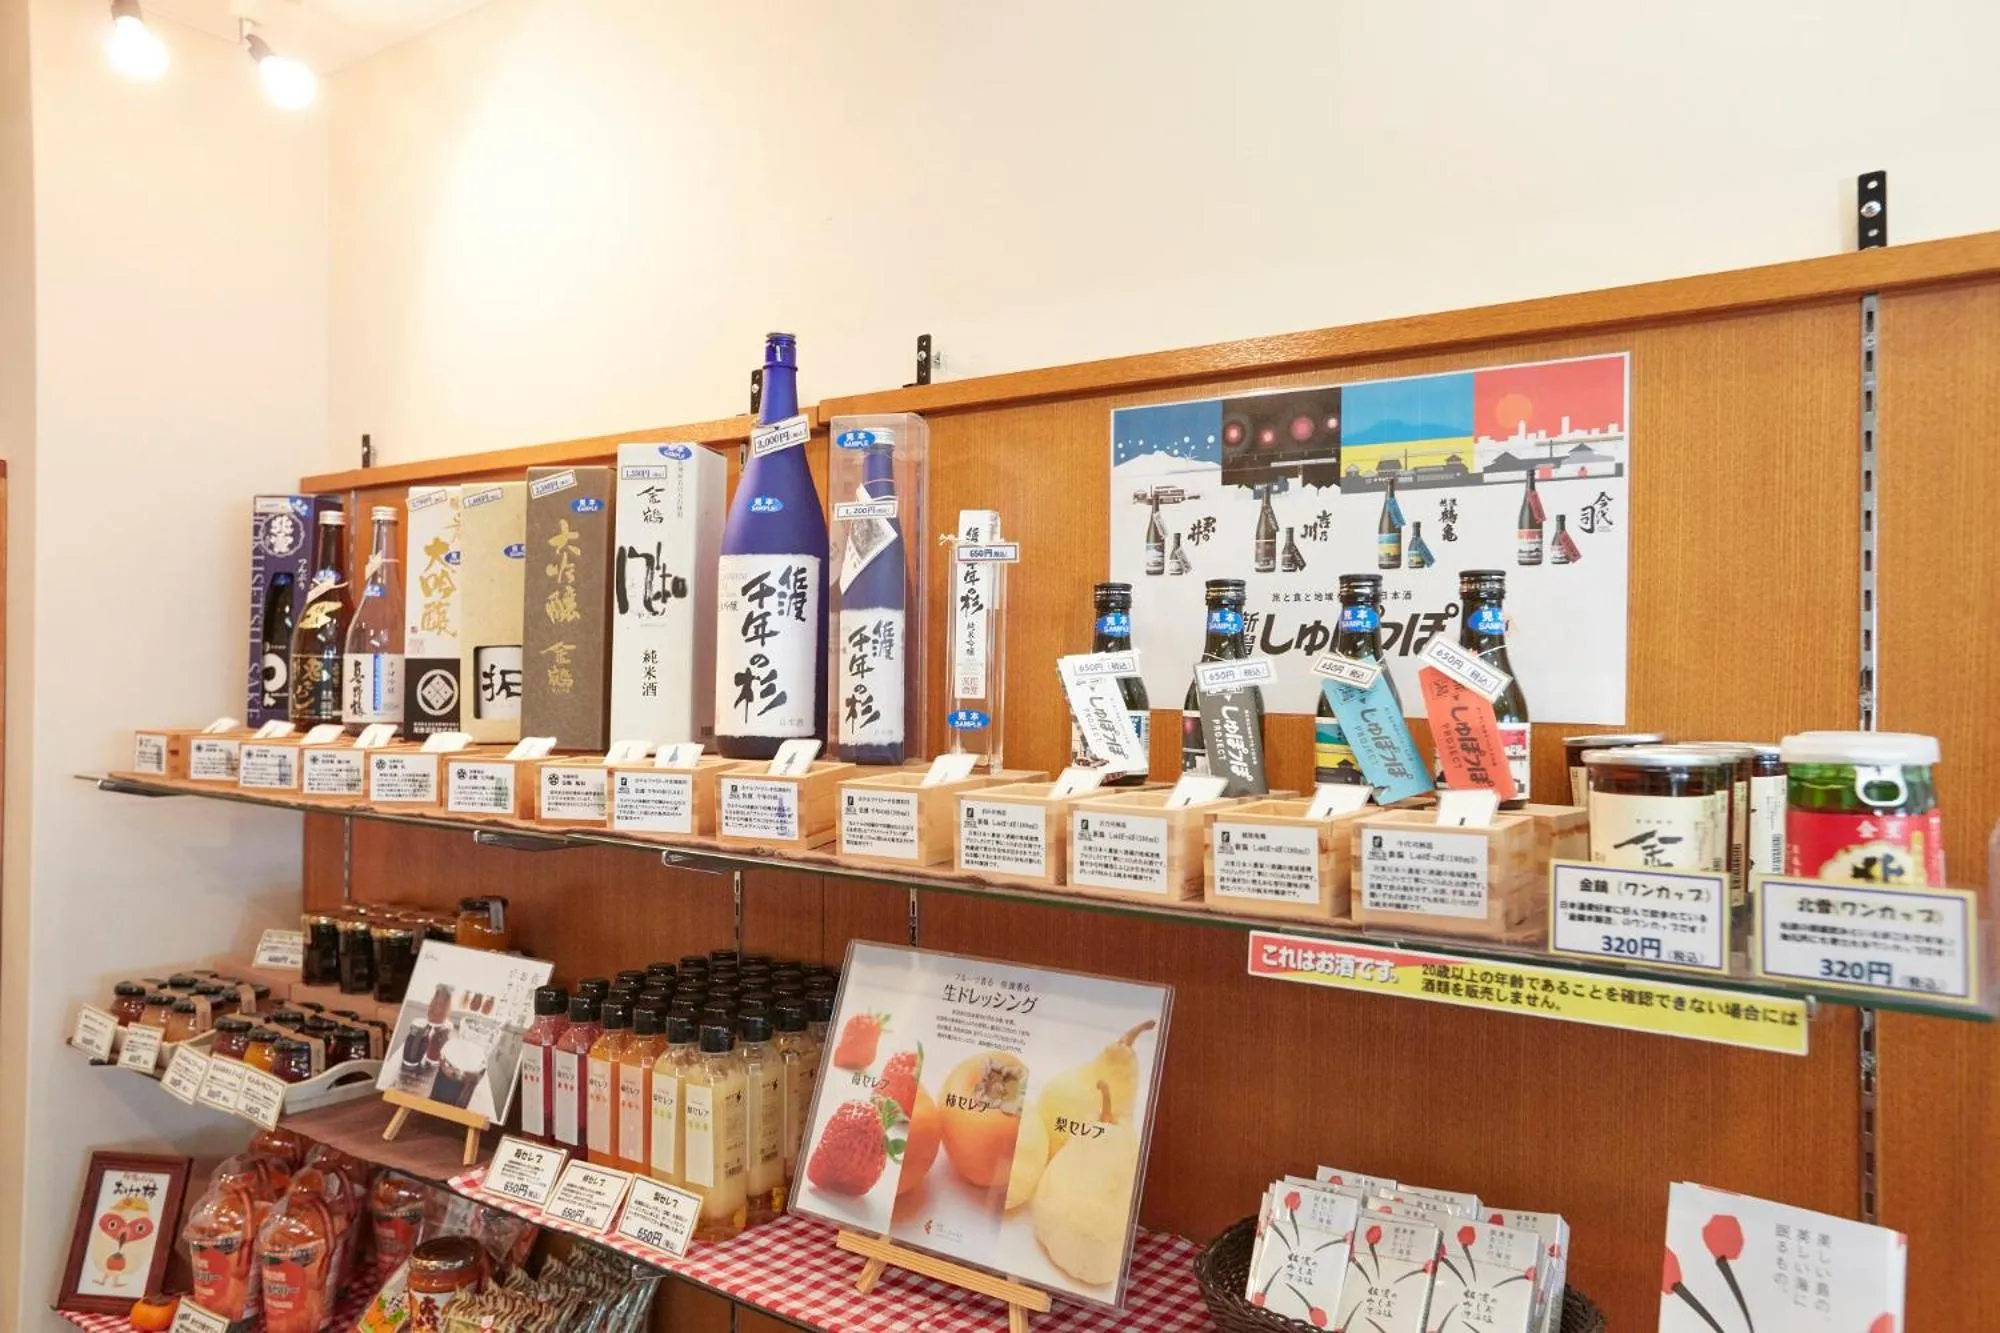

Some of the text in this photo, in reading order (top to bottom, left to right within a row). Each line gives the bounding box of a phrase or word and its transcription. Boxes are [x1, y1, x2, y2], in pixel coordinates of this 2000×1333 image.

[734, 571, 787, 723] 千年の杉
[1260, 603, 1459, 657] しゅっぽ
[845, 625, 881, 734] 千年の杉
[1222, 705, 1254, 782] しゅぽっぽ
[1360, 707, 1414, 780] しゅぽっぽ
[1451, 706, 1494, 787] しゅぽっぽ
[1262, 944, 1400, 985] これはお酒です。
[1601, 935, 1661, 959] 320円
[1820, 959, 1892, 984] 320円
[942, 984, 1038, 1014] 生ドレッシング
[1422, 963, 1800, 1027] 20歳以上の年齢であることを確認できない場合には
[1422, 978, 1562, 1012] 酒類を販売しません。
[1054, 1116, 1105, 1139] 梨セレブ
